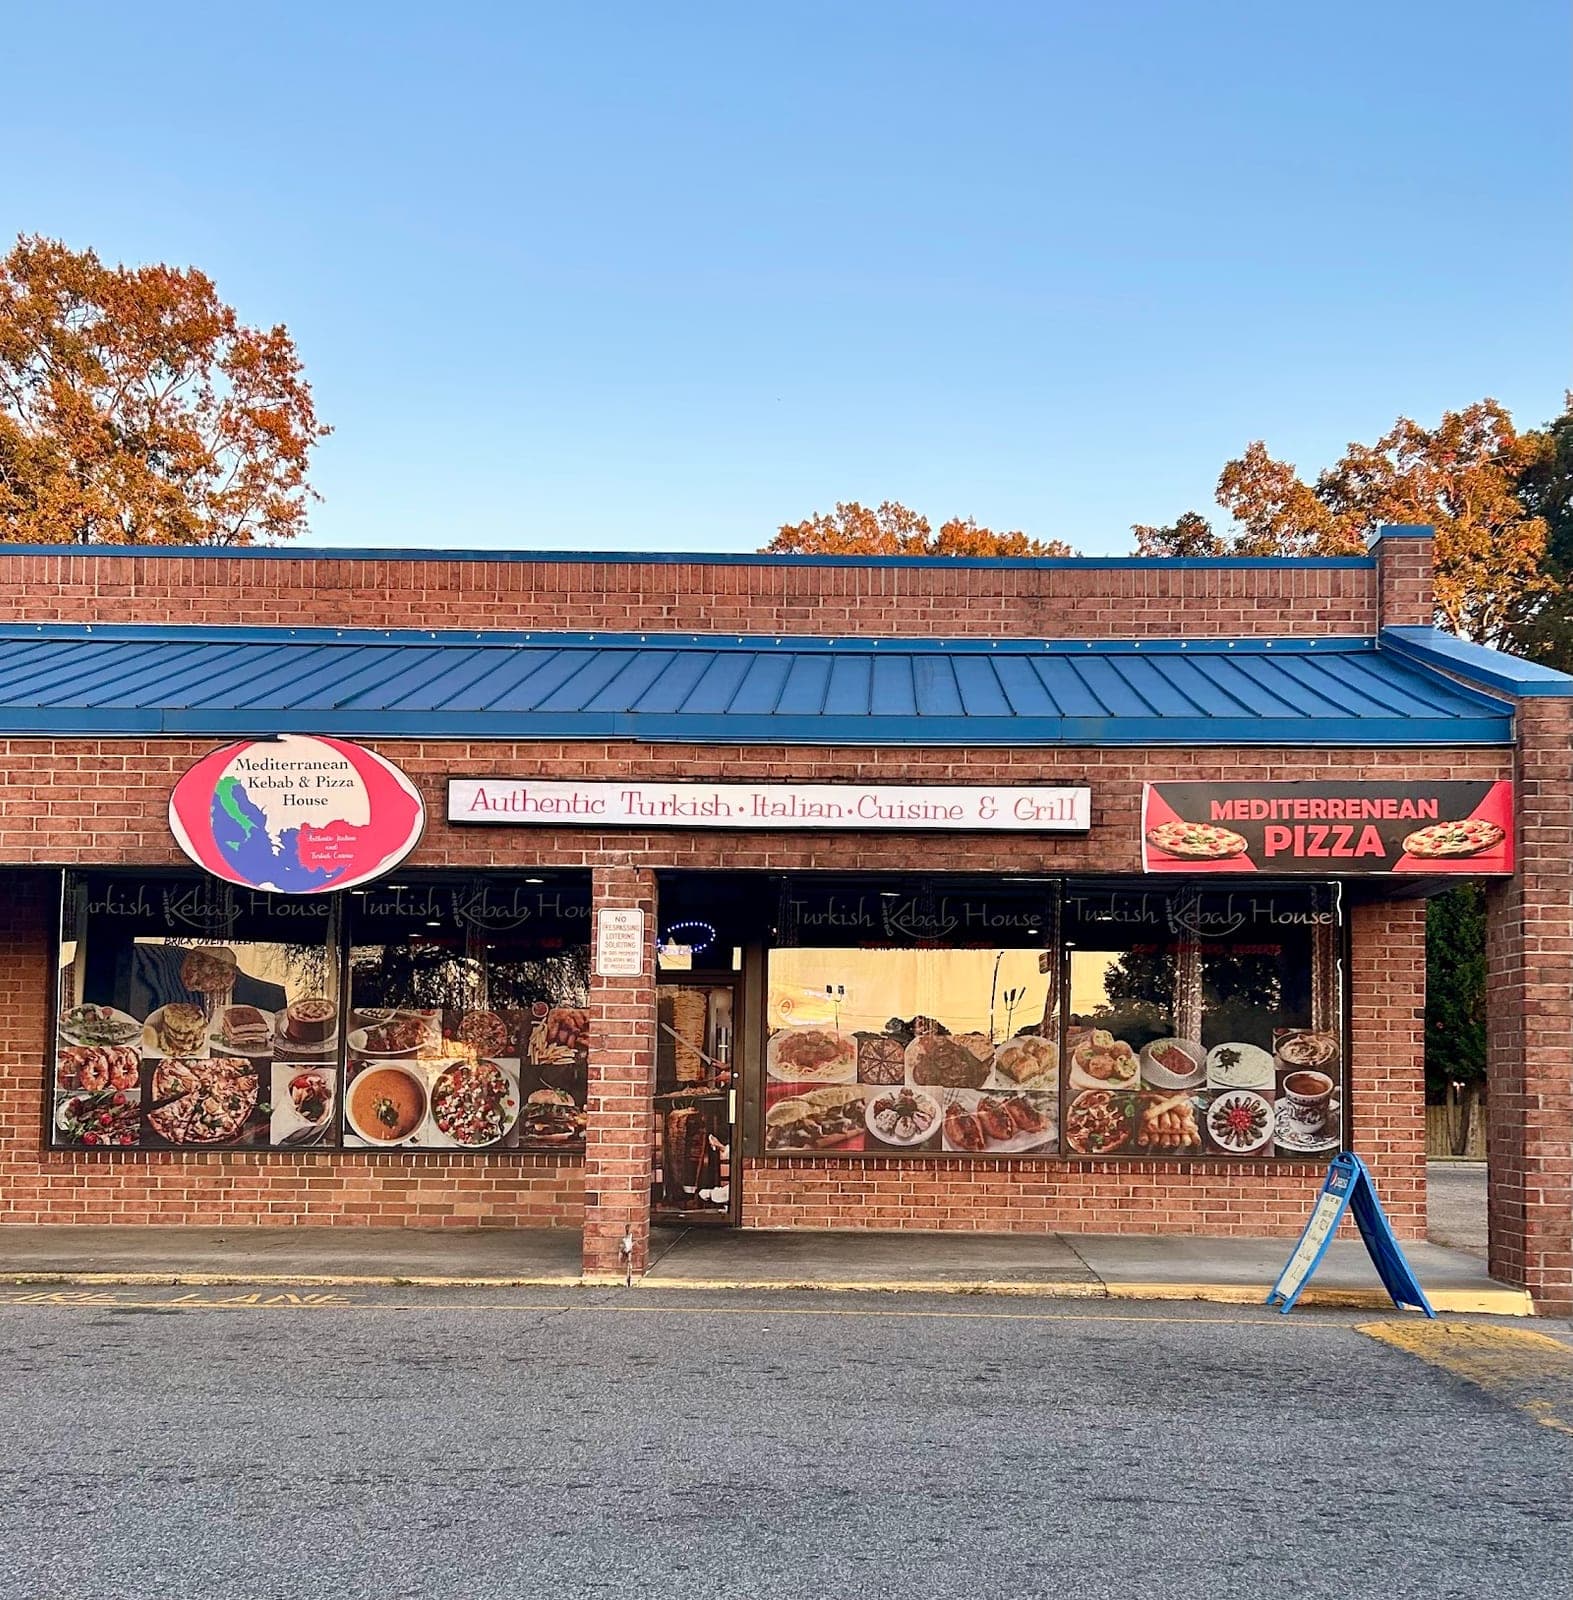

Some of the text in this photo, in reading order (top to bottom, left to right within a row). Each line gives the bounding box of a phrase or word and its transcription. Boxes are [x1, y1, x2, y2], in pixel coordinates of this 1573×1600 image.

[235, 758, 349, 771] Mediterranean
[248, 775, 354, 789] Kebab & Pizza
[282, 794, 329, 806] House
[467, 786, 1077, 821] Authentic Turkish Italian Cuisine & Grill
[1210, 798, 1439, 821] MEDITERRENEAN
[1263, 824, 1386, 857] PIZZA
[162, 883, 243, 929] Kebab
[250, 891, 331, 917] House
[357, 885, 593, 930] Turkish Kebab Hou
[790, 896, 1043, 939] Turkish Kebab House
[1070, 892, 1335, 937] Turkish Kebab House
[170, 1292, 368, 1304] LANE
